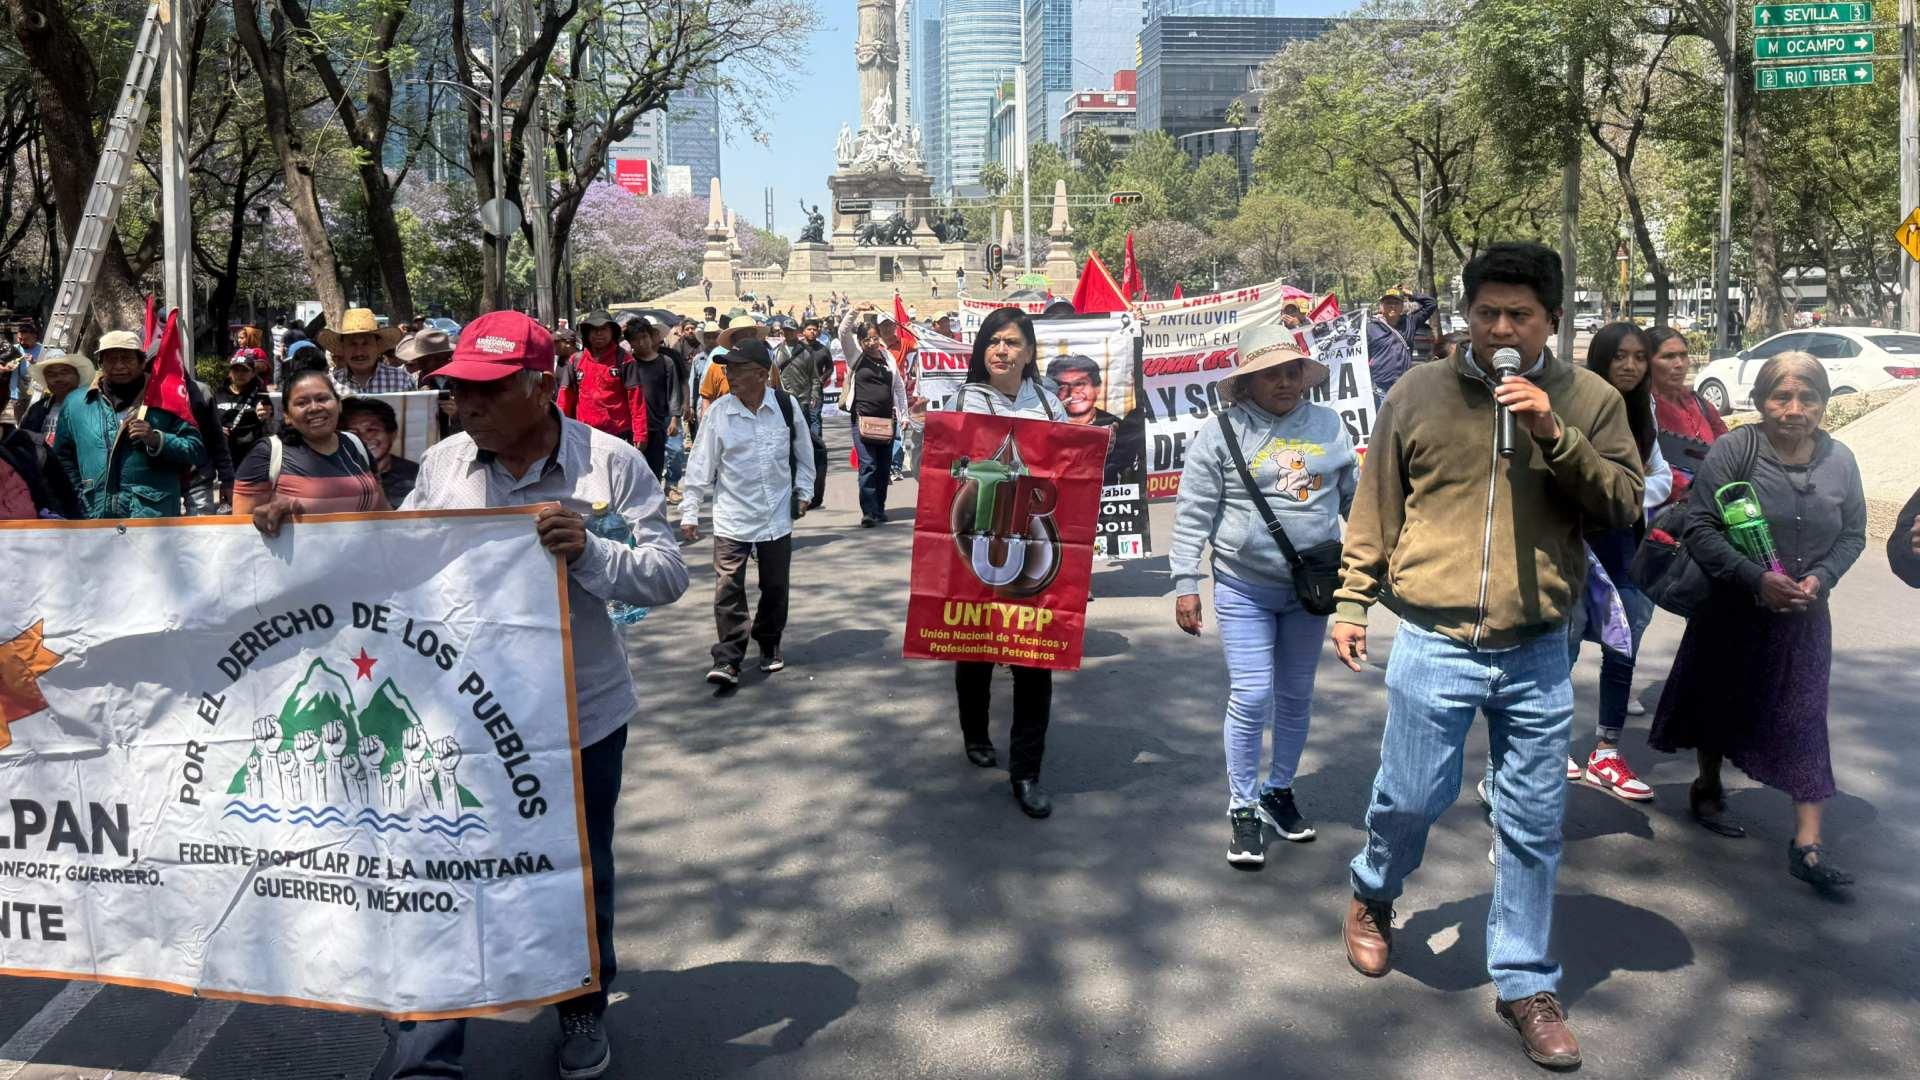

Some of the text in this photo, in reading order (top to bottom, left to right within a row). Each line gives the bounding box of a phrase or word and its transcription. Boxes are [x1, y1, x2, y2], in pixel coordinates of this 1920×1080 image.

[1784, 7, 1839, 22] SEVILLA
[1768, 39, 1845, 54] M OCAMPO
[1785, 71, 1807, 84] RIO
[1813, 69, 1847, 83] TIBER
[1177, 333, 1207, 347] VIDA
[1213, 332, 1230, 345] EN
[1346, 346, 1362, 357] MN
[1102, 487, 1131, 497] ablo
[943, 601, 1054, 632] UNTYPP
[920, 628, 1069, 650] Unión Nacional de Técnicos y
[929, 642, 1056, 661] Profesionistas Petroleros
[180, 602, 548, 819] POR EL DERECHO DE LOS PUEBLOS
[179, 843, 555, 881] FRENTE POPULAR DE LA MONTAÑA
[0, 861, 165, 887] NFORT, GUERRERO.
[254, 876, 459, 913] GUERRERO, MÉXICO.
